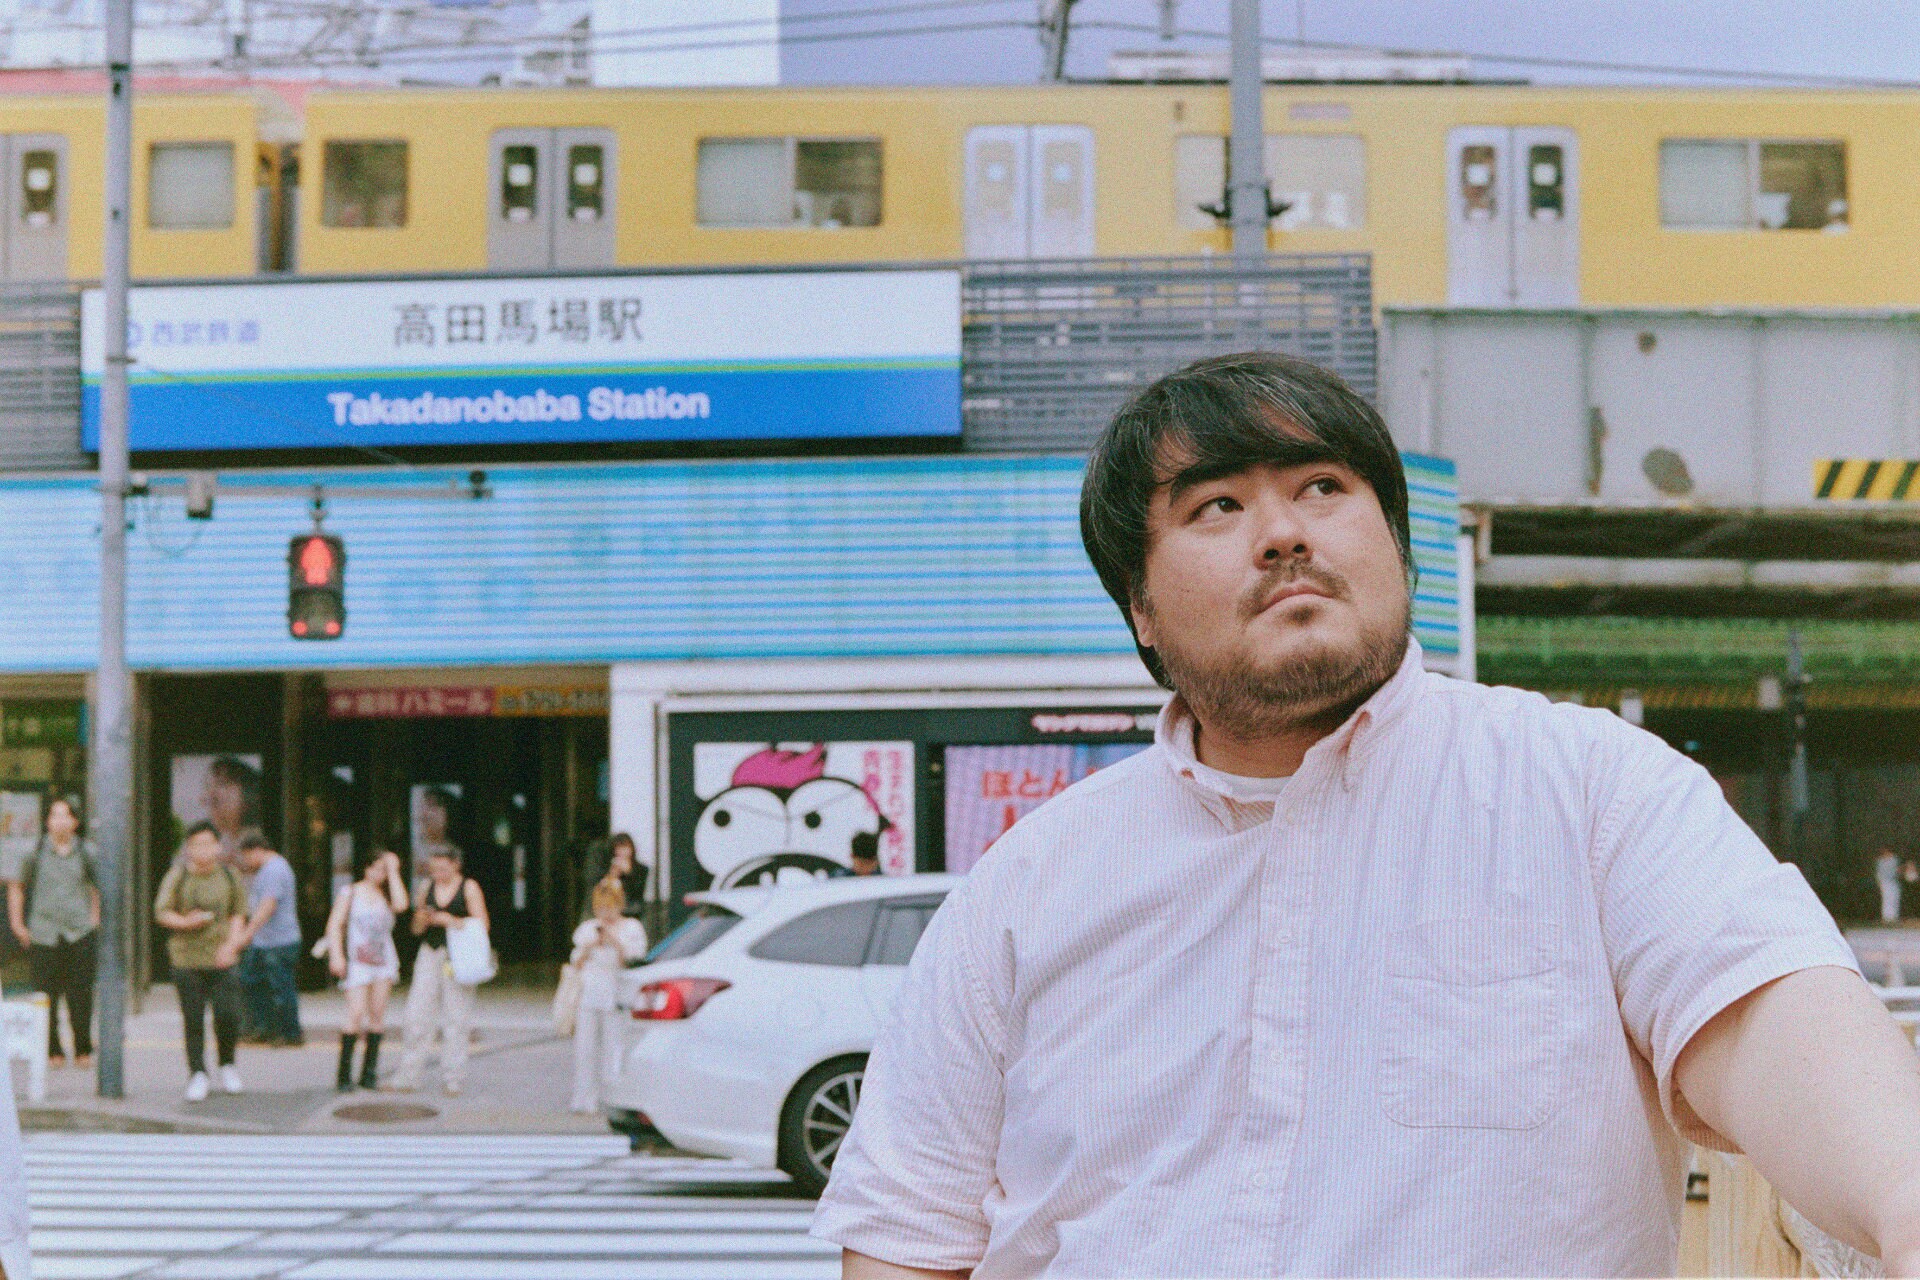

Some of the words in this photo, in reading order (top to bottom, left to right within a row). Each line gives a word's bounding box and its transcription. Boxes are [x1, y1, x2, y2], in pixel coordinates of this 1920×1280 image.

[394, 297, 642, 346] 高田馬場駅
[327, 388, 582, 427] Takadanobaba
[587, 386, 711, 422] Station
[981, 769, 1098, 798] ほとん
